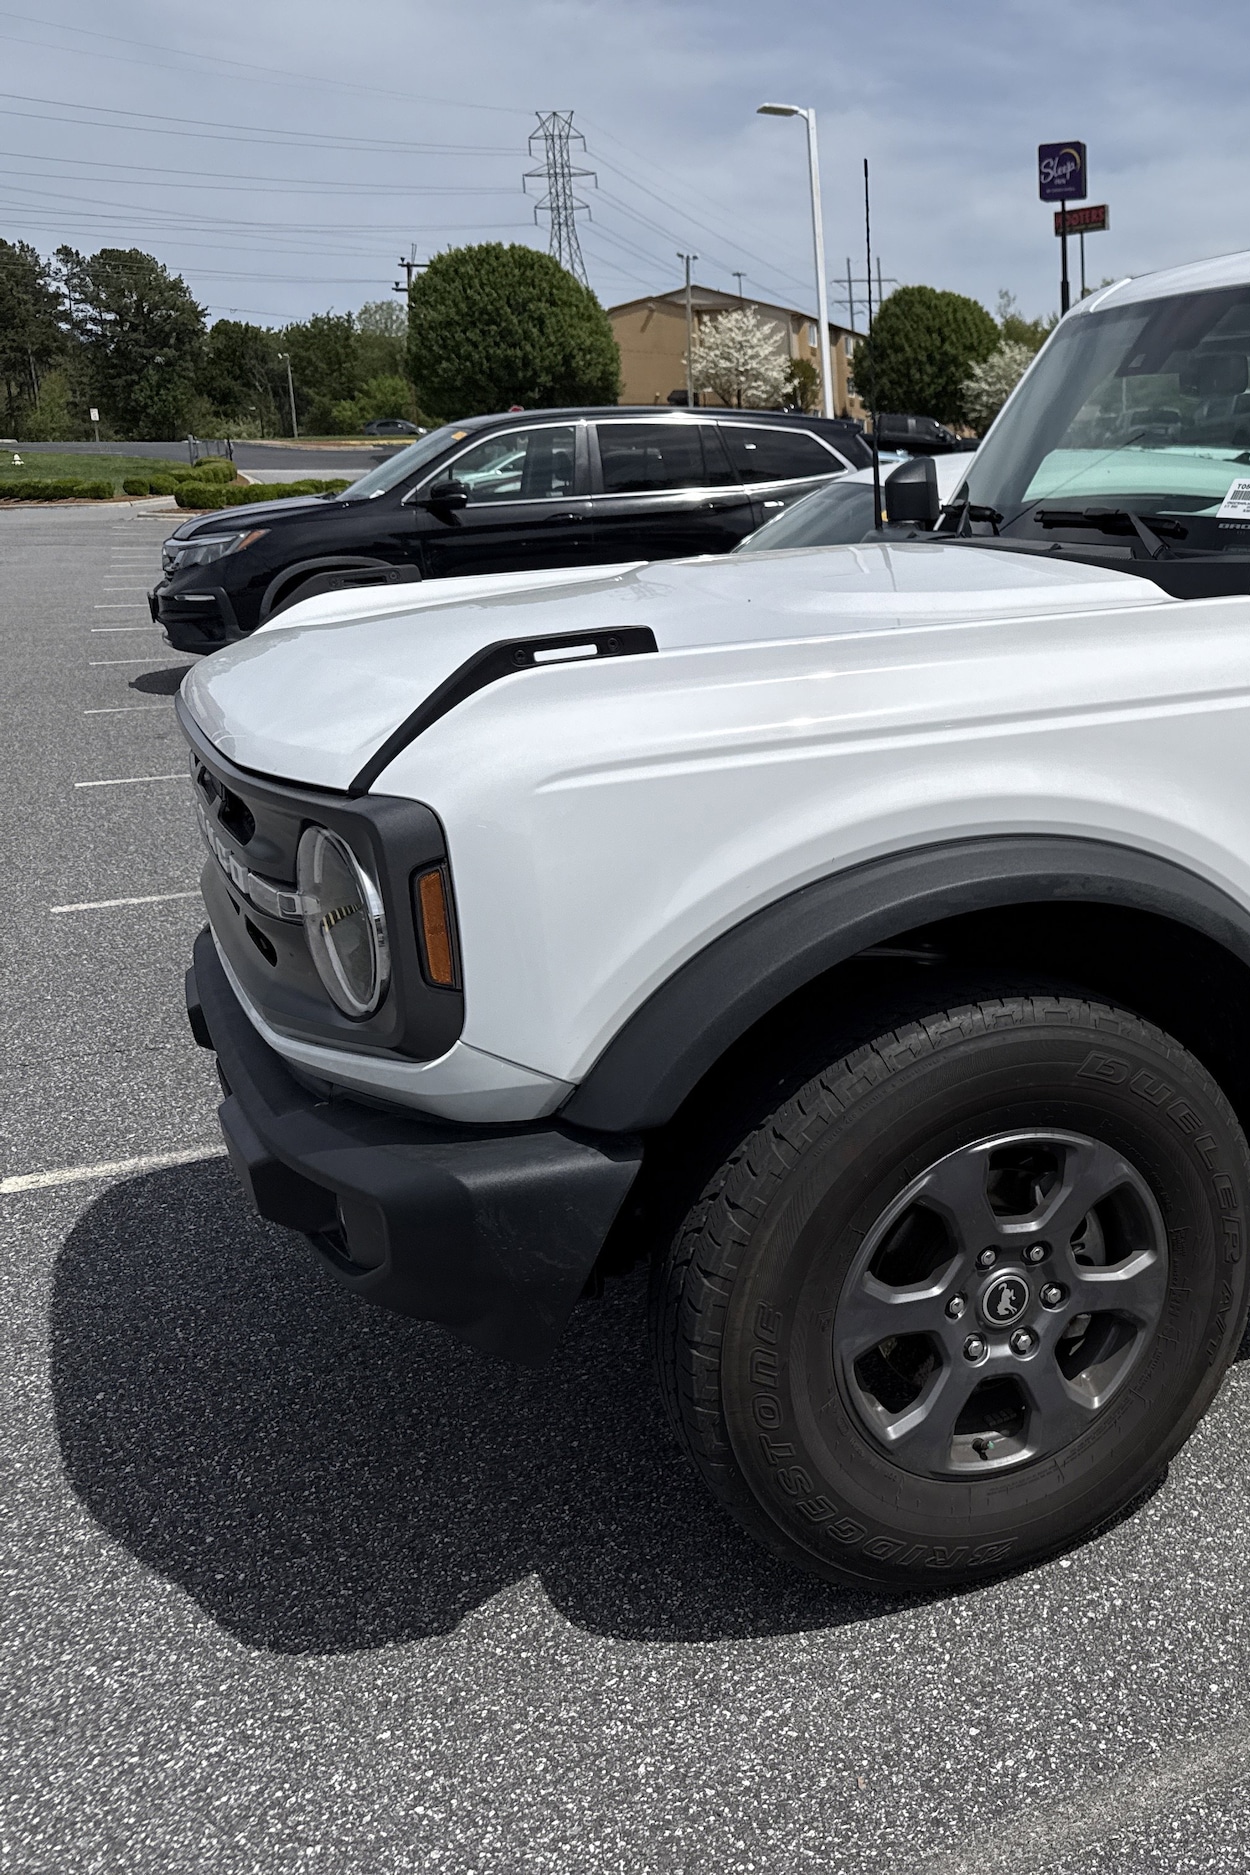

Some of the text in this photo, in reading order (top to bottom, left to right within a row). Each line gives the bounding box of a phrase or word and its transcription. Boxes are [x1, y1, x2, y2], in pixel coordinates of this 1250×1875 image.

[1041, 157, 1076, 184] Sleep
[1077, 1050, 1242, 1264] DUELER
[749, 1302, 1018, 1568] BRIDGESTONE
